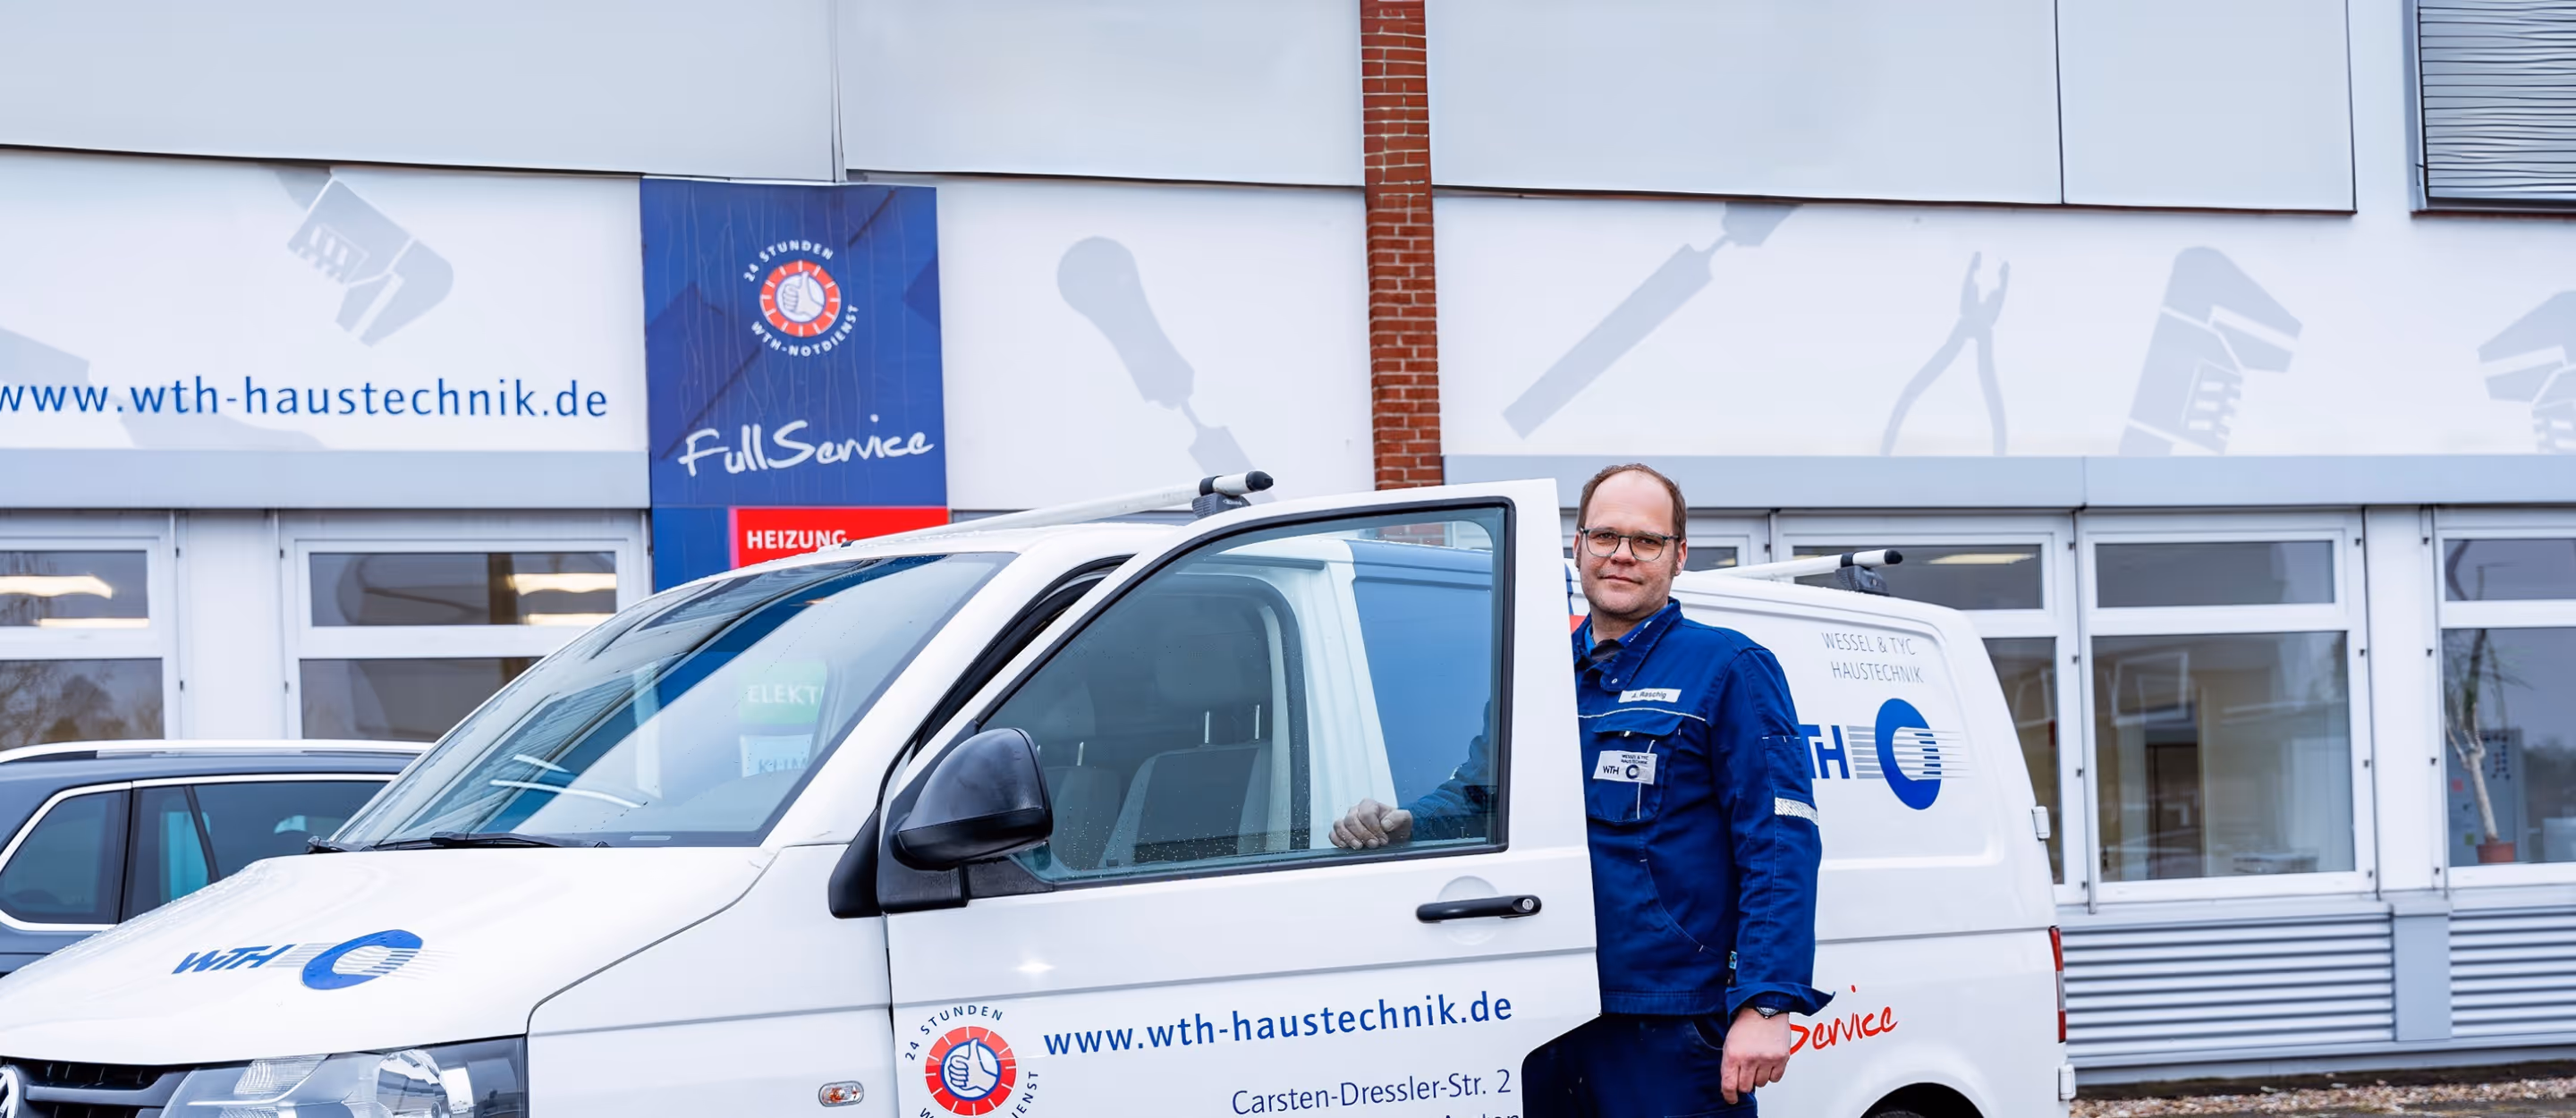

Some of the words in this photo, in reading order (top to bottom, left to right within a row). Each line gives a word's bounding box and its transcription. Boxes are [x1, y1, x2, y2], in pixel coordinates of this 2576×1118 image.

[743, 263, 759, 282] 24
[758, 240, 834, 263] STUNDEN
[751, 304, 859, 357] WTH-NOTDIENST
[0, 376, 607, 418] www.wth-haustechnik.de
[1821, 631, 1875, 653] WESSEL
[1877, 636, 1887, 653] &
[1889, 637, 1917, 656] TYC
[1831, 661, 1925, 683] HAUSTECHNIK
[747, 683, 825, 705] ELEKT
[1603, 766, 1620, 775] WTH
[1799, 724, 1851, 779] TH
[172, 944, 297, 975] WTH
[905, 1041, 920, 1061] 24
[920, 1005, 1003, 1035] STUNDEN
[1043, 991, 1513, 1055] www.wth-haustechnik.de
[1232, 1072, 1487, 1114] Carsten-Dressler-Str.
[1496, 1069, 1512, 1093] 2
